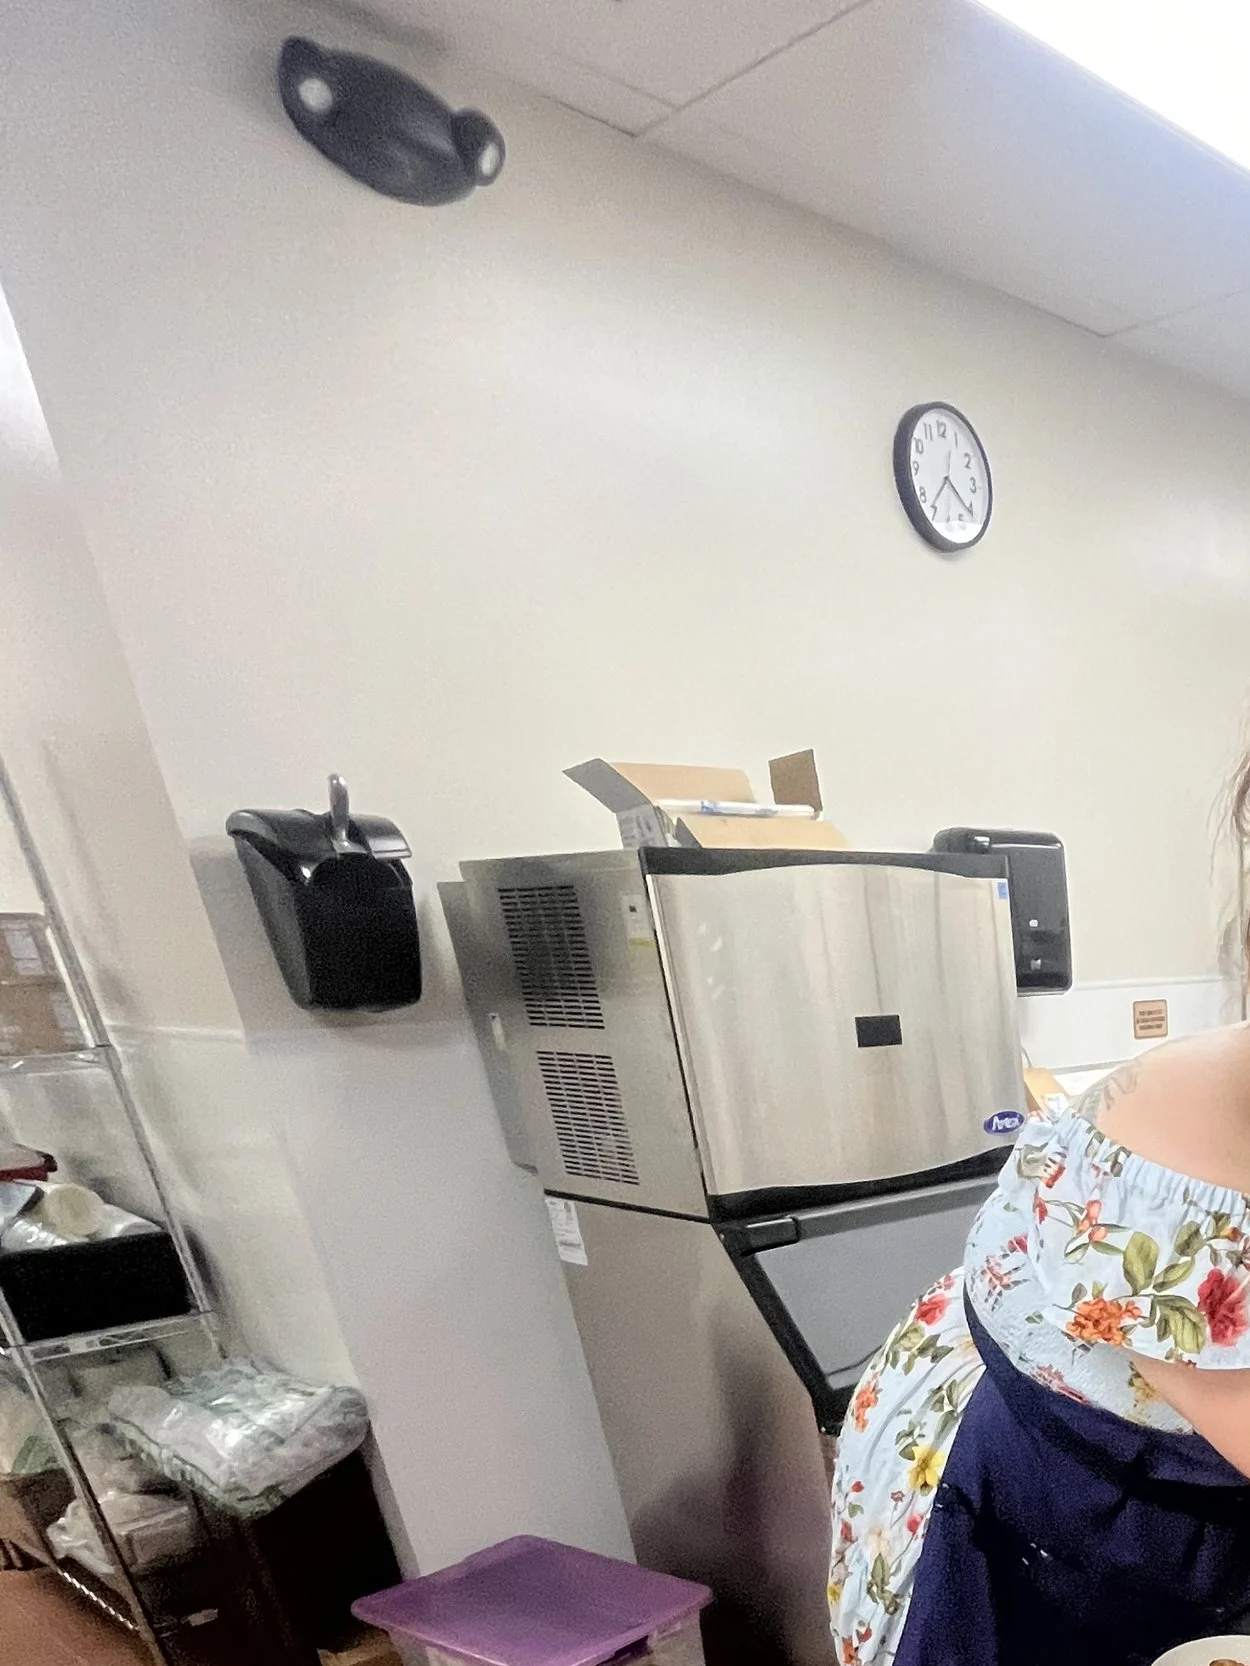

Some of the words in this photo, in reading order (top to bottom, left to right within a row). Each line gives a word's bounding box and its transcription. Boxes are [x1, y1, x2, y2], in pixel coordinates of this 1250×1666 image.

[923, 422, 933, 441] 11
[936, 420, 947, 438] 12
[913, 437, 924, 455] 10
[912, 460, 920, 476] 9
[963, 452, 971, 469] 2
[969, 477, 977, 494] 3
[919, 486, 927, 503] 8
